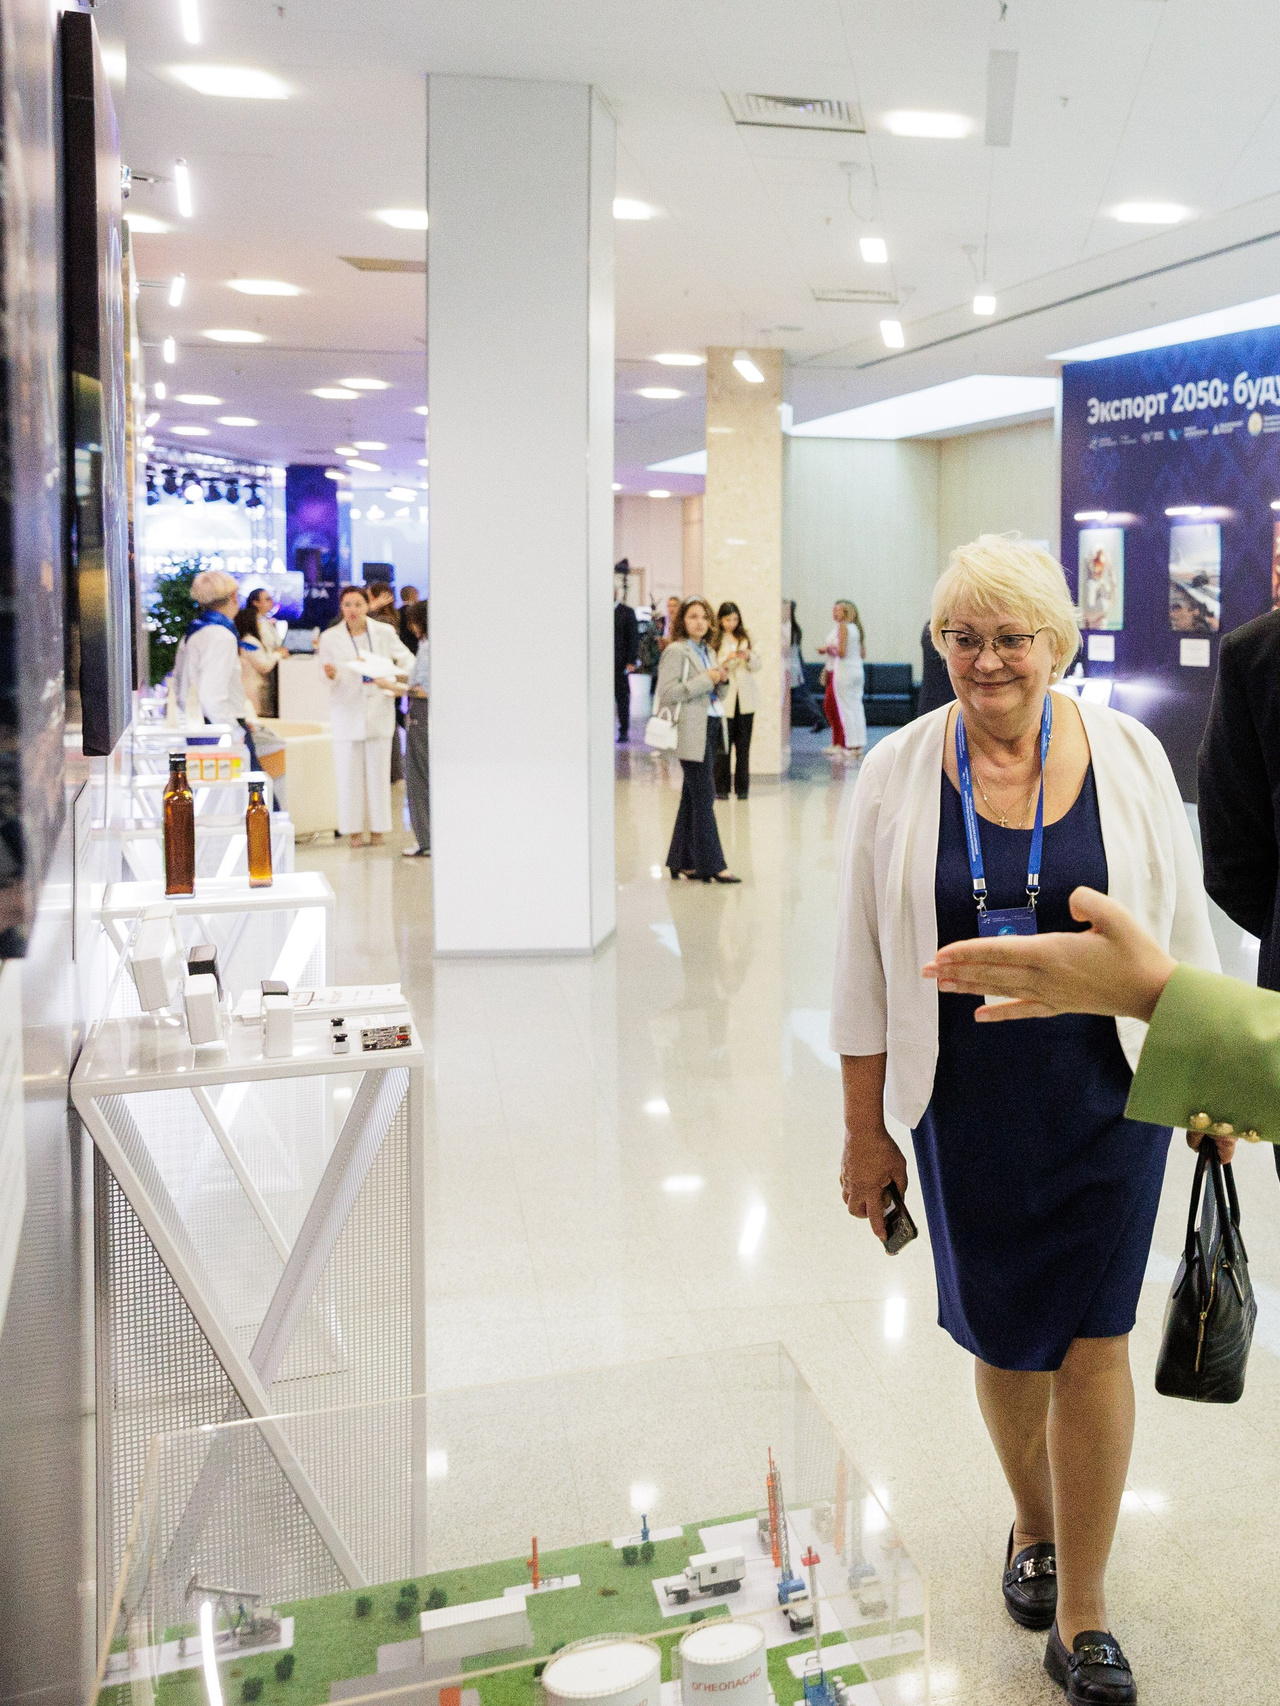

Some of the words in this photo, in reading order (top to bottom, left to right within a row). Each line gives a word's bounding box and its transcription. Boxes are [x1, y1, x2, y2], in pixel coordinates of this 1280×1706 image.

[1087, 391, 1168, 425] Экспорт
[1170, 376, 1230, 413] 2050:
[691, 1666, 762, 1692] ОГНЕОПАСНО
